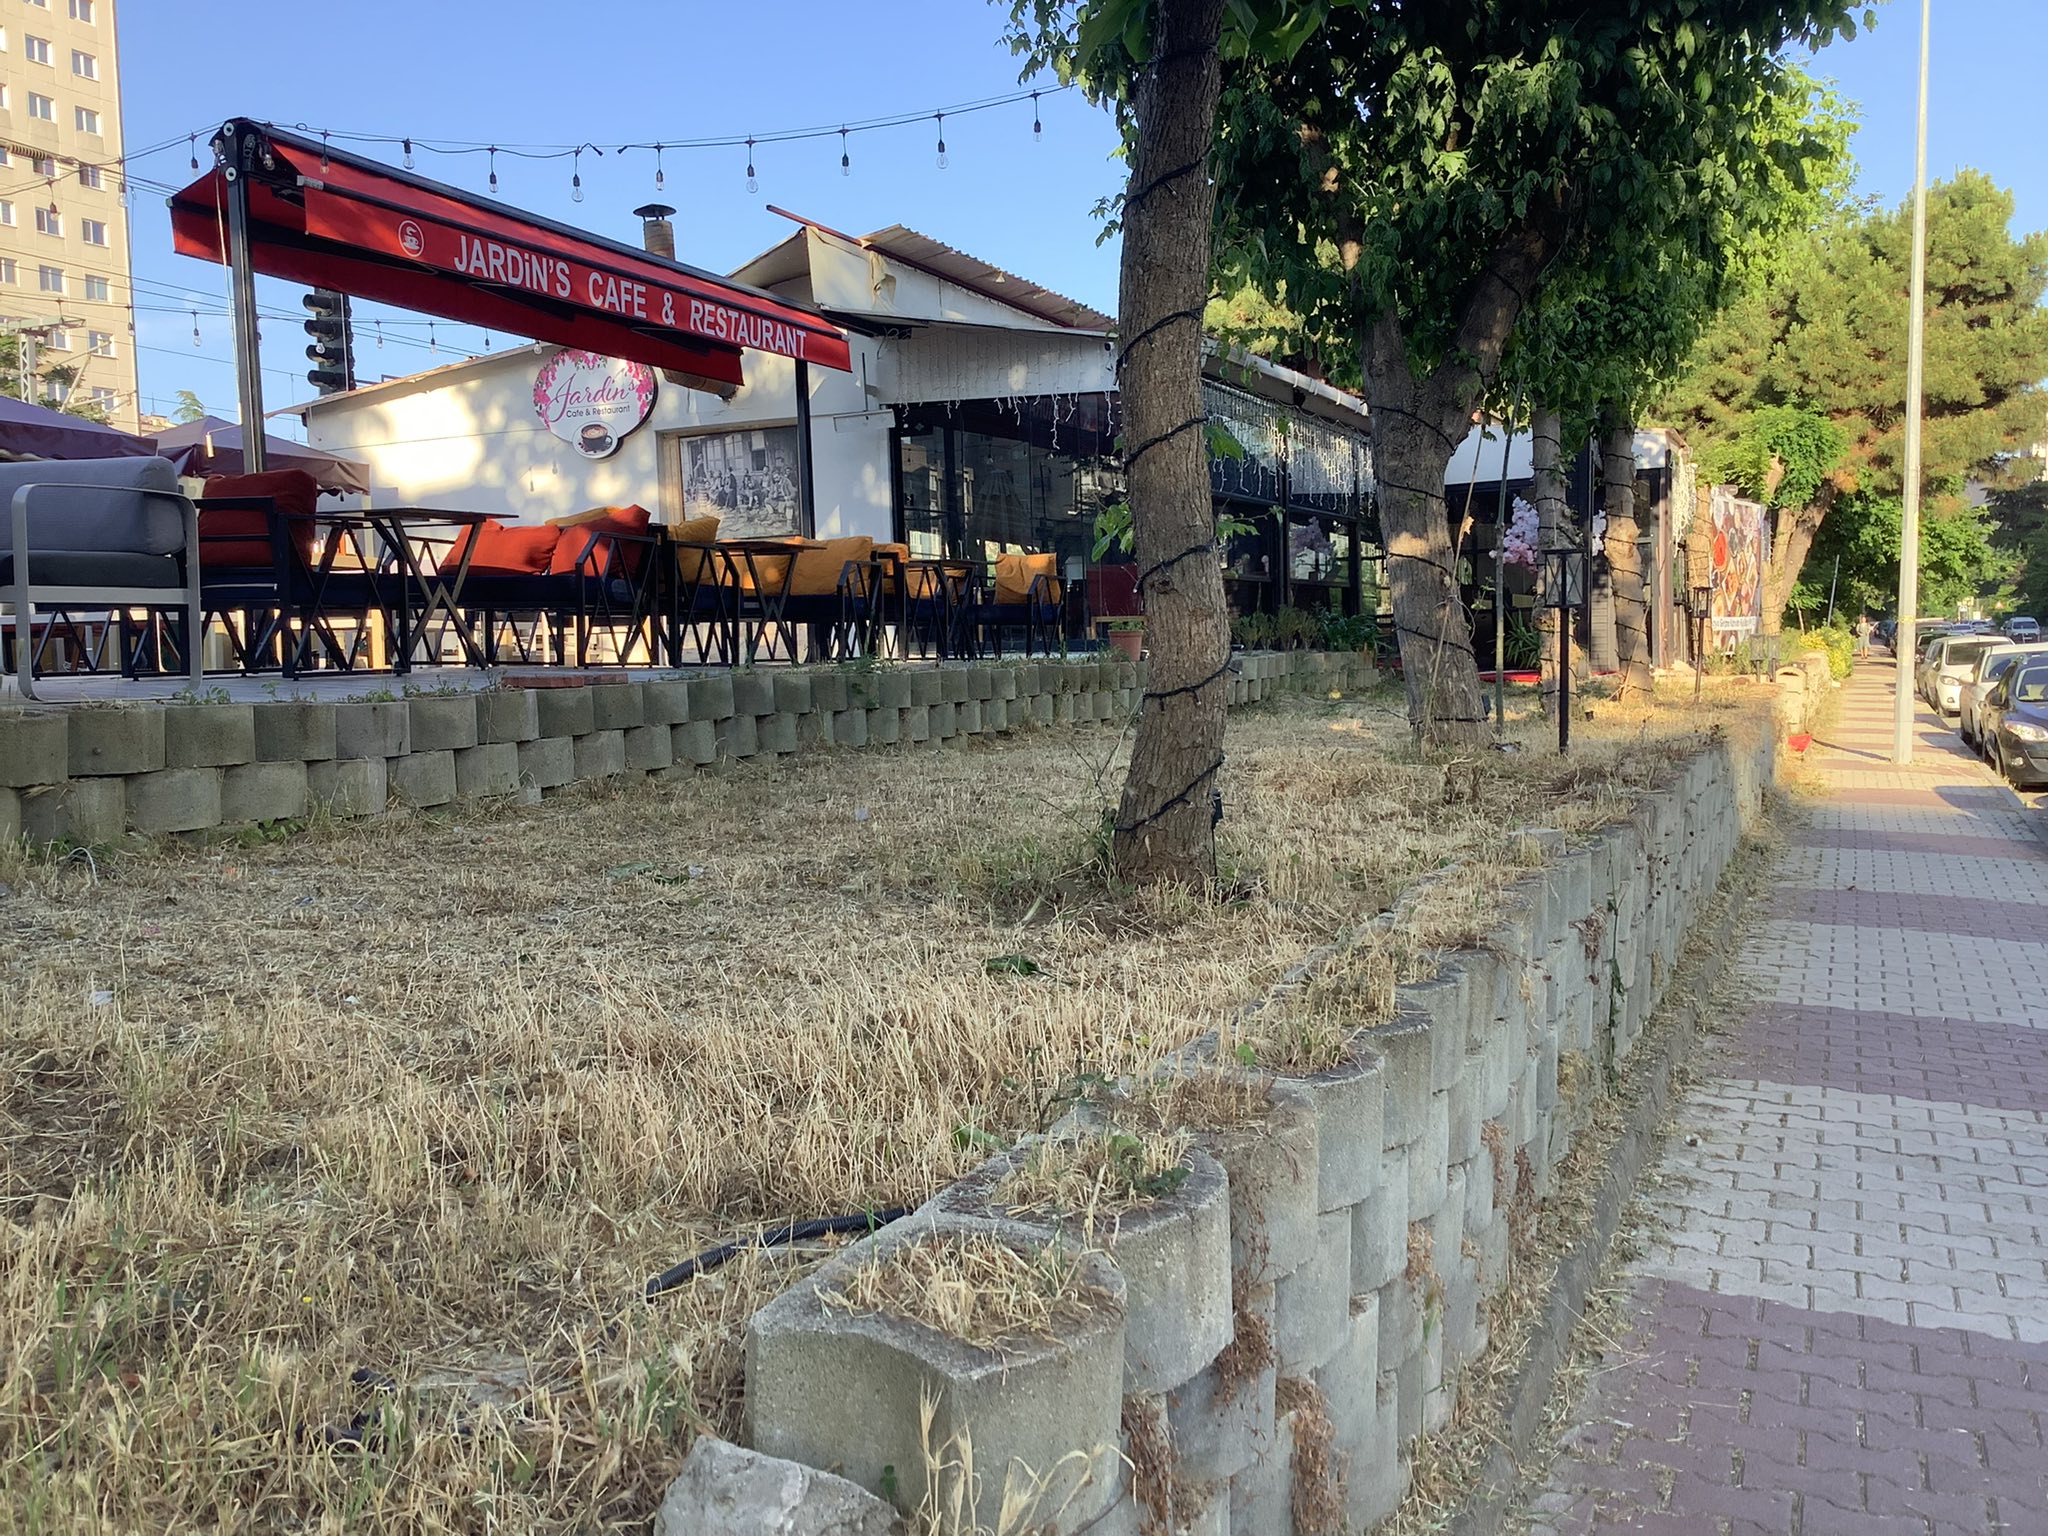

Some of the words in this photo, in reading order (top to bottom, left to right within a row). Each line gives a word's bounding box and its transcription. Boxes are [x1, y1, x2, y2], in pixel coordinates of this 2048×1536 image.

[588, 271, 647, 319] CAFE
[662, 292, 676, 326] &
[690, 299, 807, 358] RESTAURANT
[566, 409, 584, 418] Cafe
[585, 408, 591, 416] &
[592, 404, 631, 416] Restaurant
